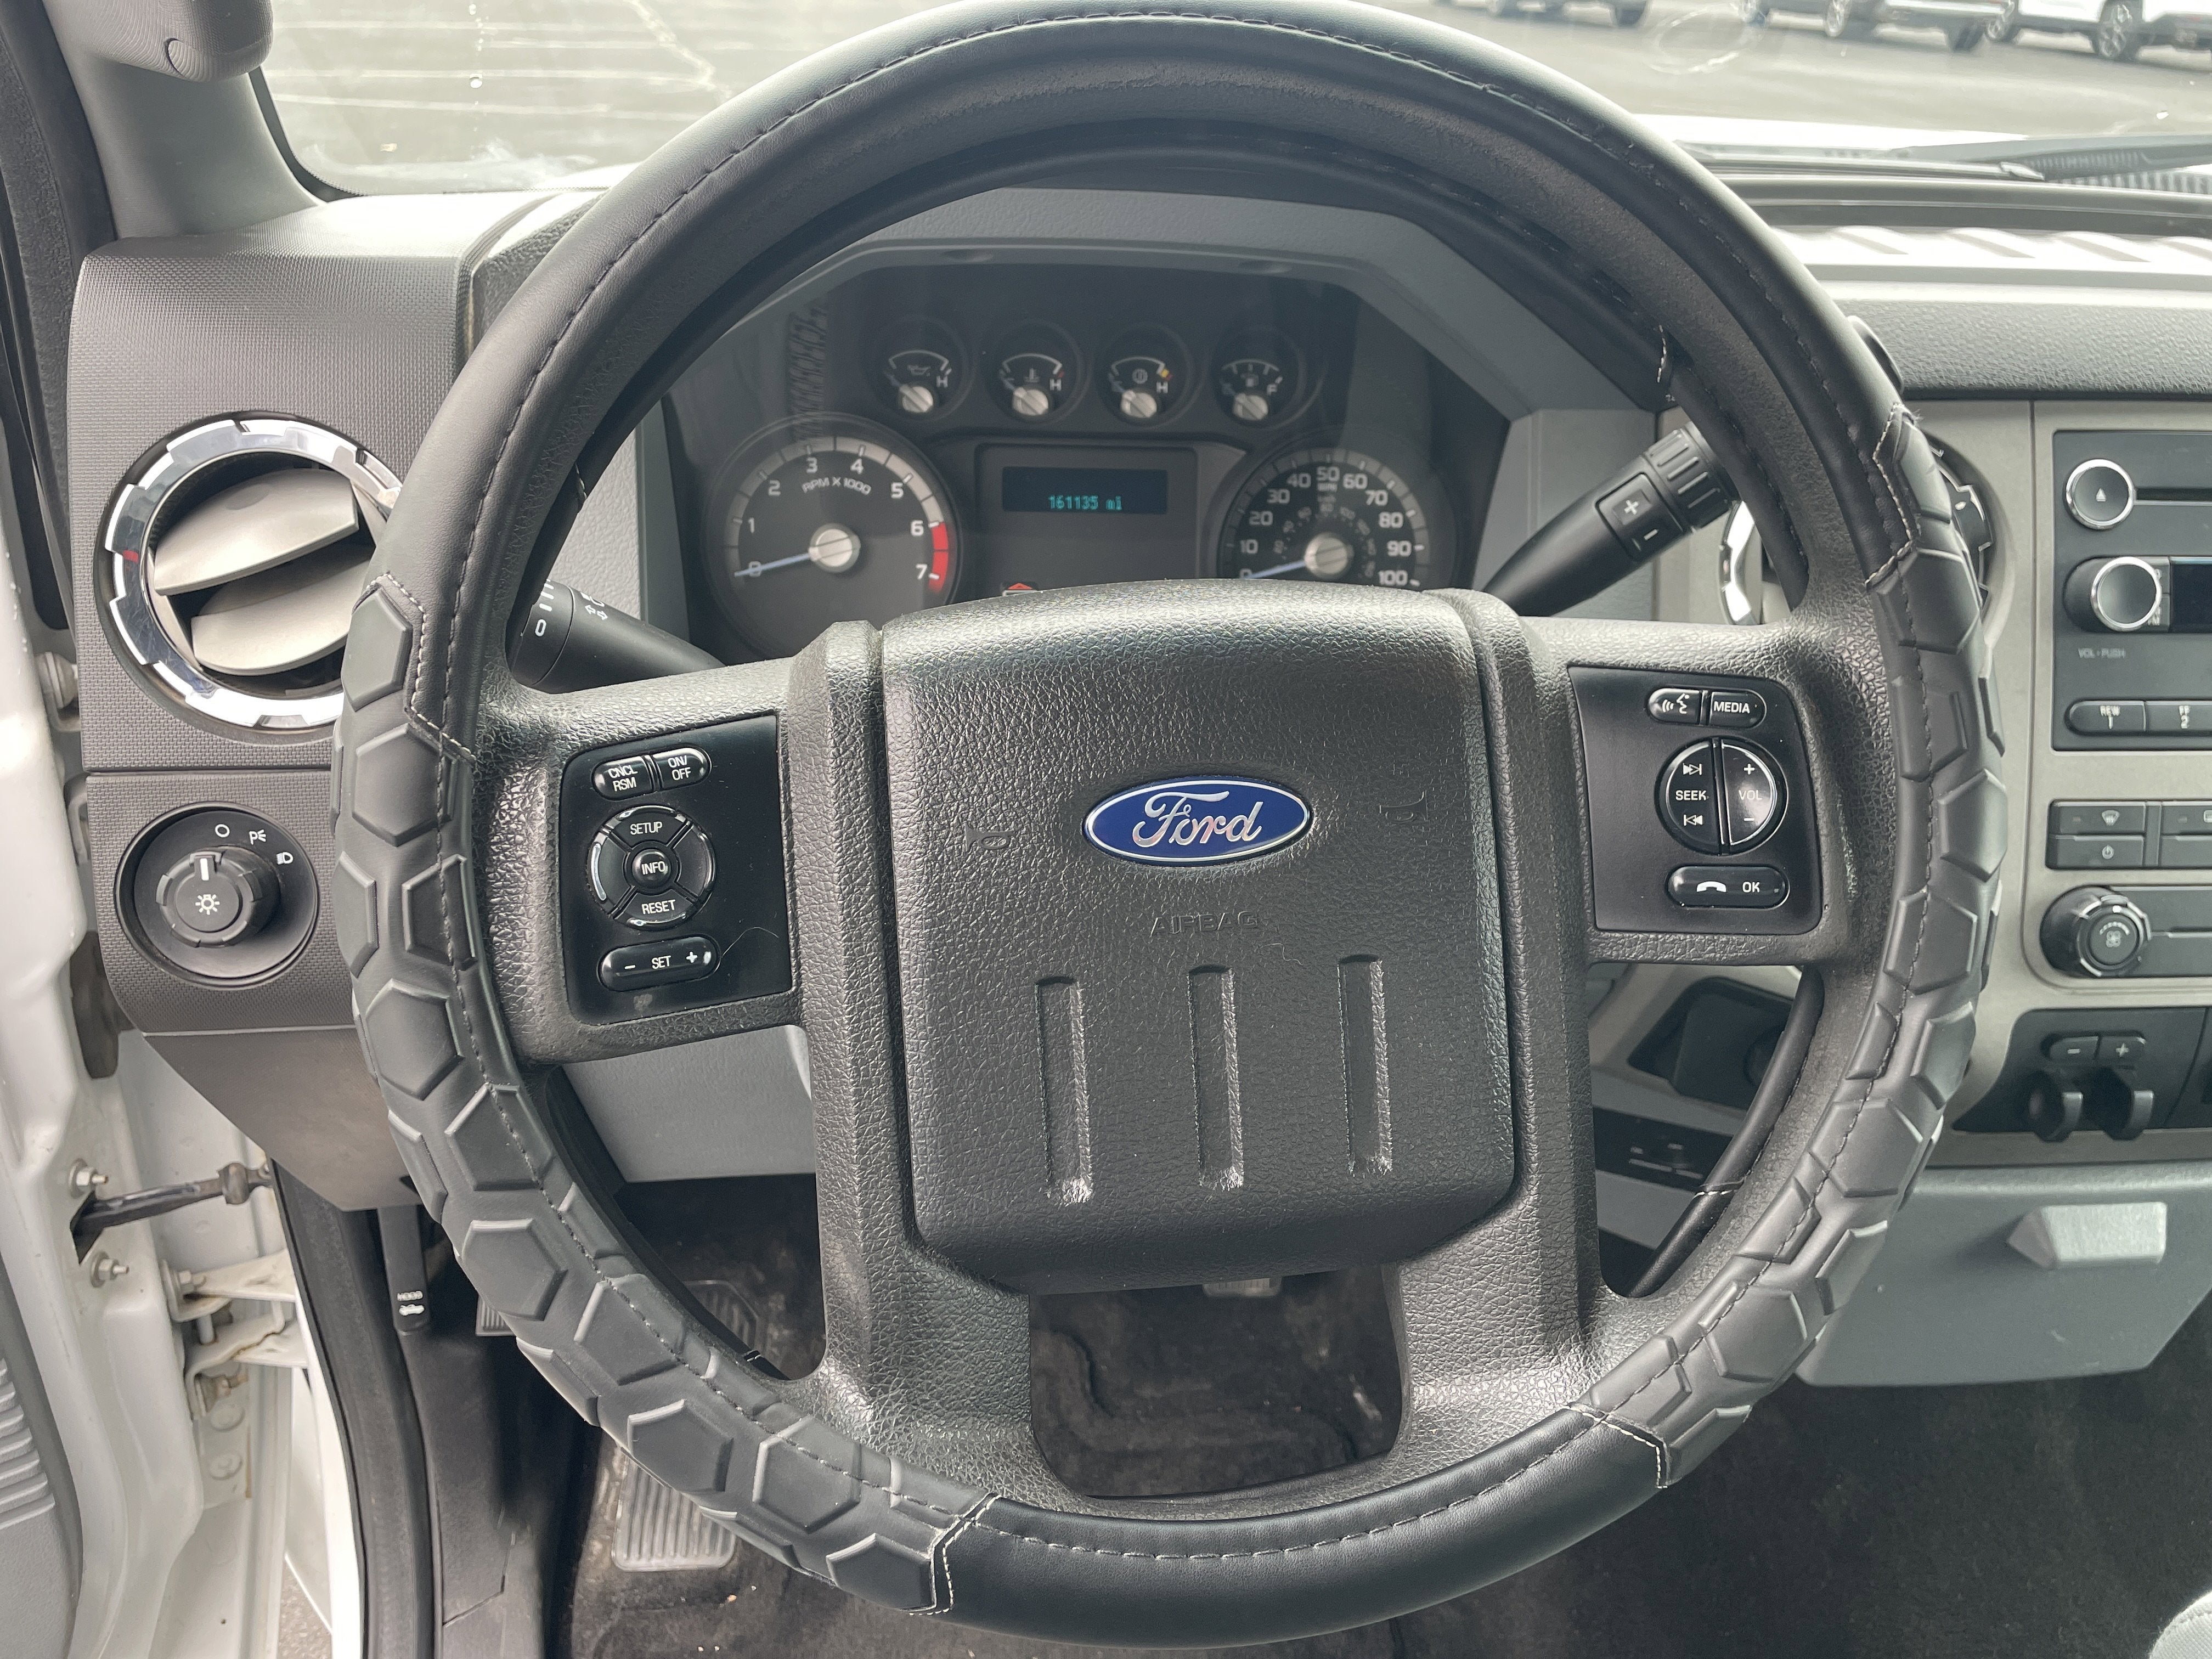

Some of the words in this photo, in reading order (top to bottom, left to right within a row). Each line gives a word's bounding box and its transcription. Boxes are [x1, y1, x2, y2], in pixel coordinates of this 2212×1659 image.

[1049, 379, 1062, 391] H
[1156, 381, 1169, 393] H
[806, 458, 818, 473] 3
[850, 459, 864, 474] 4
[1287, 473, 1311, 488] 40
[1317, 466, 1340, 482] 50
[1343, 473, 1368, 489] 60
[769, 481, 781, 496] 2
[802, 477, 830, 493] RPM
[843, 477, 872, 495] 1000
[891, 483, 903, 499] 5
[1048, 495, 1098, 510] 161135
[1105, 496, 1122, 510] mi
[1267, 489, 1290, 504] 30
[1365, 490, 1388, 505] 70
[748, 517, 755, 533] 1
[1249, 511, 1273, 526] 20
[1379, 512, 1403, 528] 80
[911, 521, 923, 536] 6
[1240, 539, 1258, 554] 10
[1387, 541, 1412, 556] 90
[916, 564, 928, 579] 7
[1378, 569, 1408, 585] 100
[1714, 701, 1750, 714] MEDIA
[668, 755, 687, 768] ON/
[608, 766, 638, 778] CNCL
[672, 768, 691, 781] OFF
[613, 777, 636, 792] RSM
[1675, 790, 1707, 801] SEEK
[1739, 789, 1762, 800] VOL
[1132, 791, 1263, 848] Ford
[630, 821, 663, 835] SETUP
[641, 861, 665, 875] INFO
[1742, 882, 1760, 893] OK
[641, 900, 676, 915] RESET
[1150, 911, 1259, 936] AIRBAG
[652, 956, 671, 969] SET
